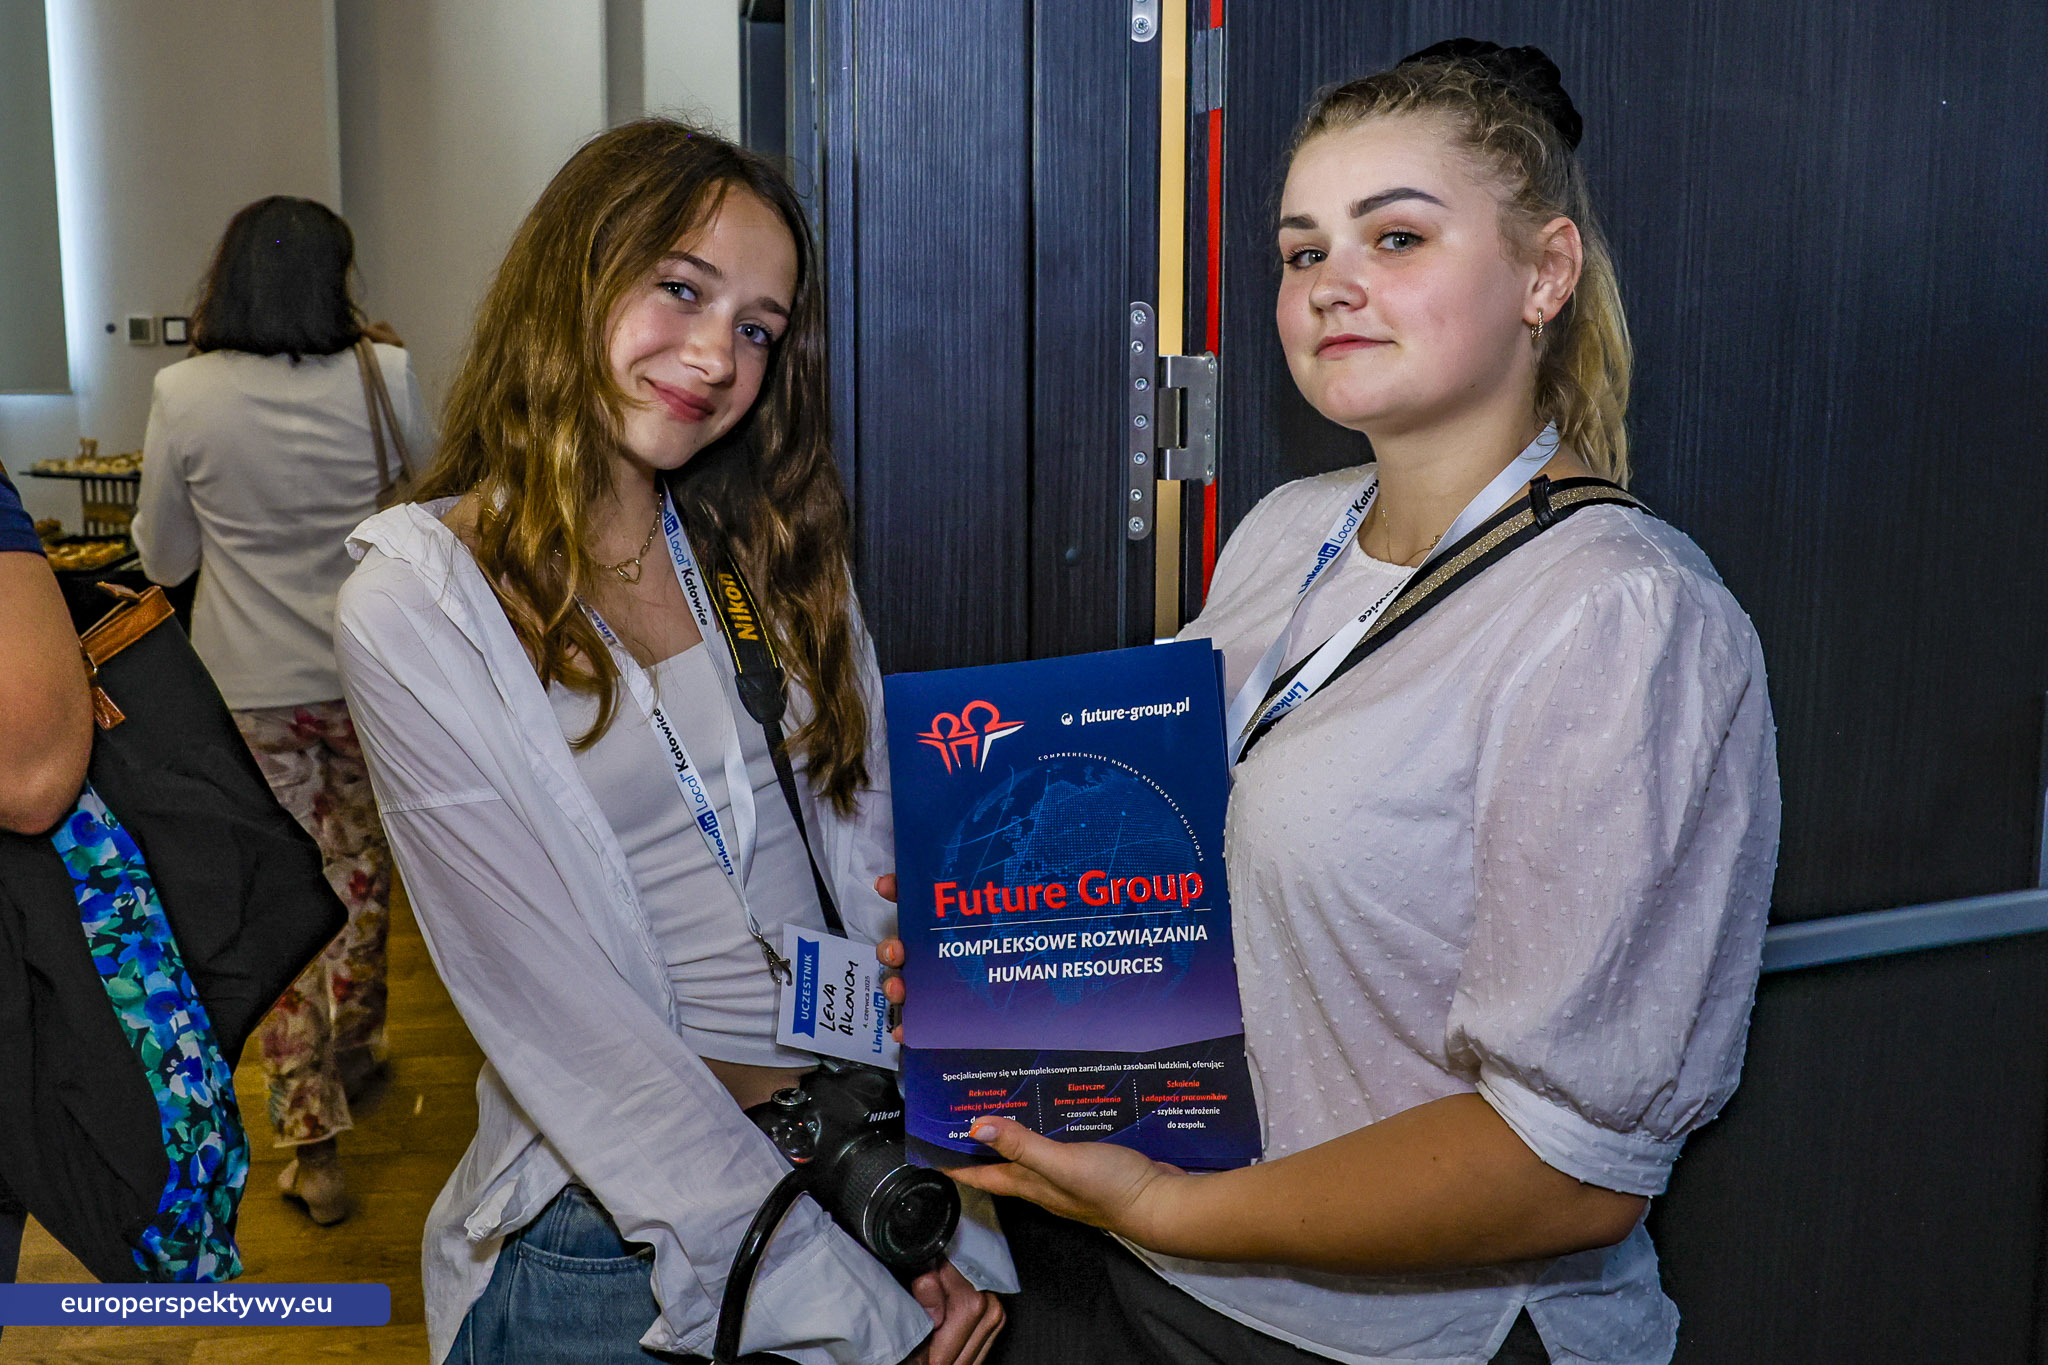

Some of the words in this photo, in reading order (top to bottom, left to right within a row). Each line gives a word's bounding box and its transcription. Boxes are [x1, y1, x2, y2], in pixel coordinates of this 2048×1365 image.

[681, 567, 708, 626] Katowice
[718, 573, 759, 641] Nikon
[1080, 697, 1190, 726] future-group.pl
[653, 708, 689, 773] Katowice
[1038, 752, 1107, 761] COMPREHENSIVE
[1111, 759, 1139, 775] HUMAN
[1142, 775, 1180, 812] RESOURCES
[1180, 814, 1204, 862] SOLUTIONS
[934, 881, 1067, 918] Future
[1078, 869, 1204, 908] Group
[938, 932, 1077, 958] KOMPLEKSOWE
[1081, 924, 1208, 949] ROZWIĄZANIA
[988, 963, 1057, 983] HUMAN
[1062, 956, 1163, 979] RESOURCES
[801, 954, 812, 1020] UCZESTNIK
[942, 1071, 998, 1082] Specjalizujemy
[999, 1069, 1009, 1078] się
[1019, 1066, 1078, 1076] kompleksowym
[1078, 1063, 1122, 1074] zarządzaniu
[1123, 1061, 1157, 1071] zasobami
[1158, 1060, 1191, 1070] ludzkimi,
[1192, 1060, 1225, 1070] oferując:
[1068, 1083, 1106, 1092] Elastyczne
[1166, 1080, 1200, 1089] Szkolenia
[969, 1088, 1007, 1097] Rekrutację
[1181, 1092, 1228, 1103] pracowników
[983, 1101, 1028, 1110] kandydatów
[1054, 1098, 1075, 1107] formy
[868, 1109, 900, 1123] Nikon
[1066, 1111, 1099, 1119] czasowe,
[1100, 1109, 1118, 1117] stałe
[1157, 1106, 1183, 1117] szybkie
[1184, 1106, 1220, 1116] wdrożenie
[1070, 1122, 1114, 1133] outsourcing.
[1167, 1120, 1176, 1129] do
[1177, 1120, 1206, 1130] zespołu.
[948, 1130, 958, 1139] do
